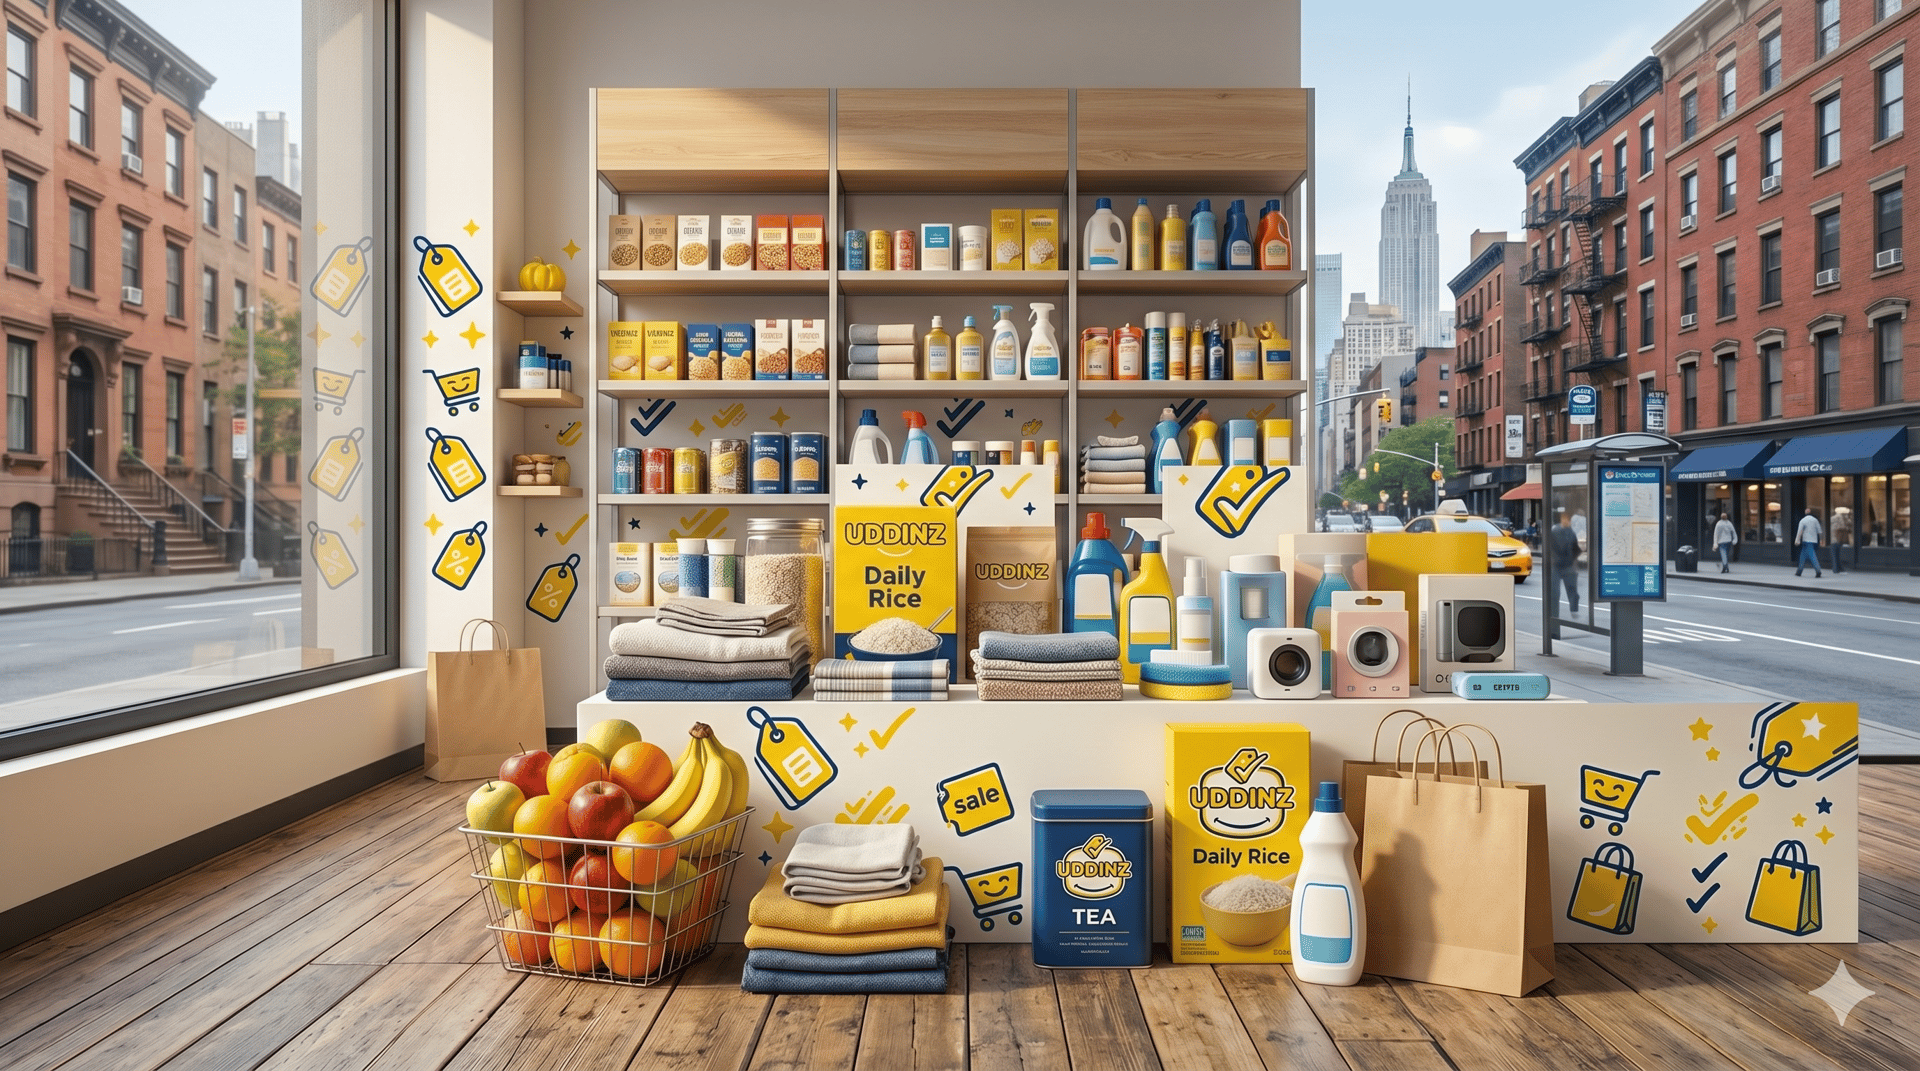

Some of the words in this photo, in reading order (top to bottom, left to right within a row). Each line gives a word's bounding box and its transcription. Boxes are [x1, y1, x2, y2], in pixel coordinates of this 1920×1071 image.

[845, 522, 947, 546] UDDINZ
[864, 565, 926, 588] Daily
[975, 563, 1049, 580] UDDINZ
[868, 588, 922, 608] Rice
[954, 786, 1000, 814] sale
[1189, 787, 1296, 809] UDDINZ
[1193, 847, 1242, 868] Daily
[1248, 847, 1290, 865] Rice
[1057, 861, 1132, 878] UDDINZ
[1072, 908, 1117, 925] TEA
